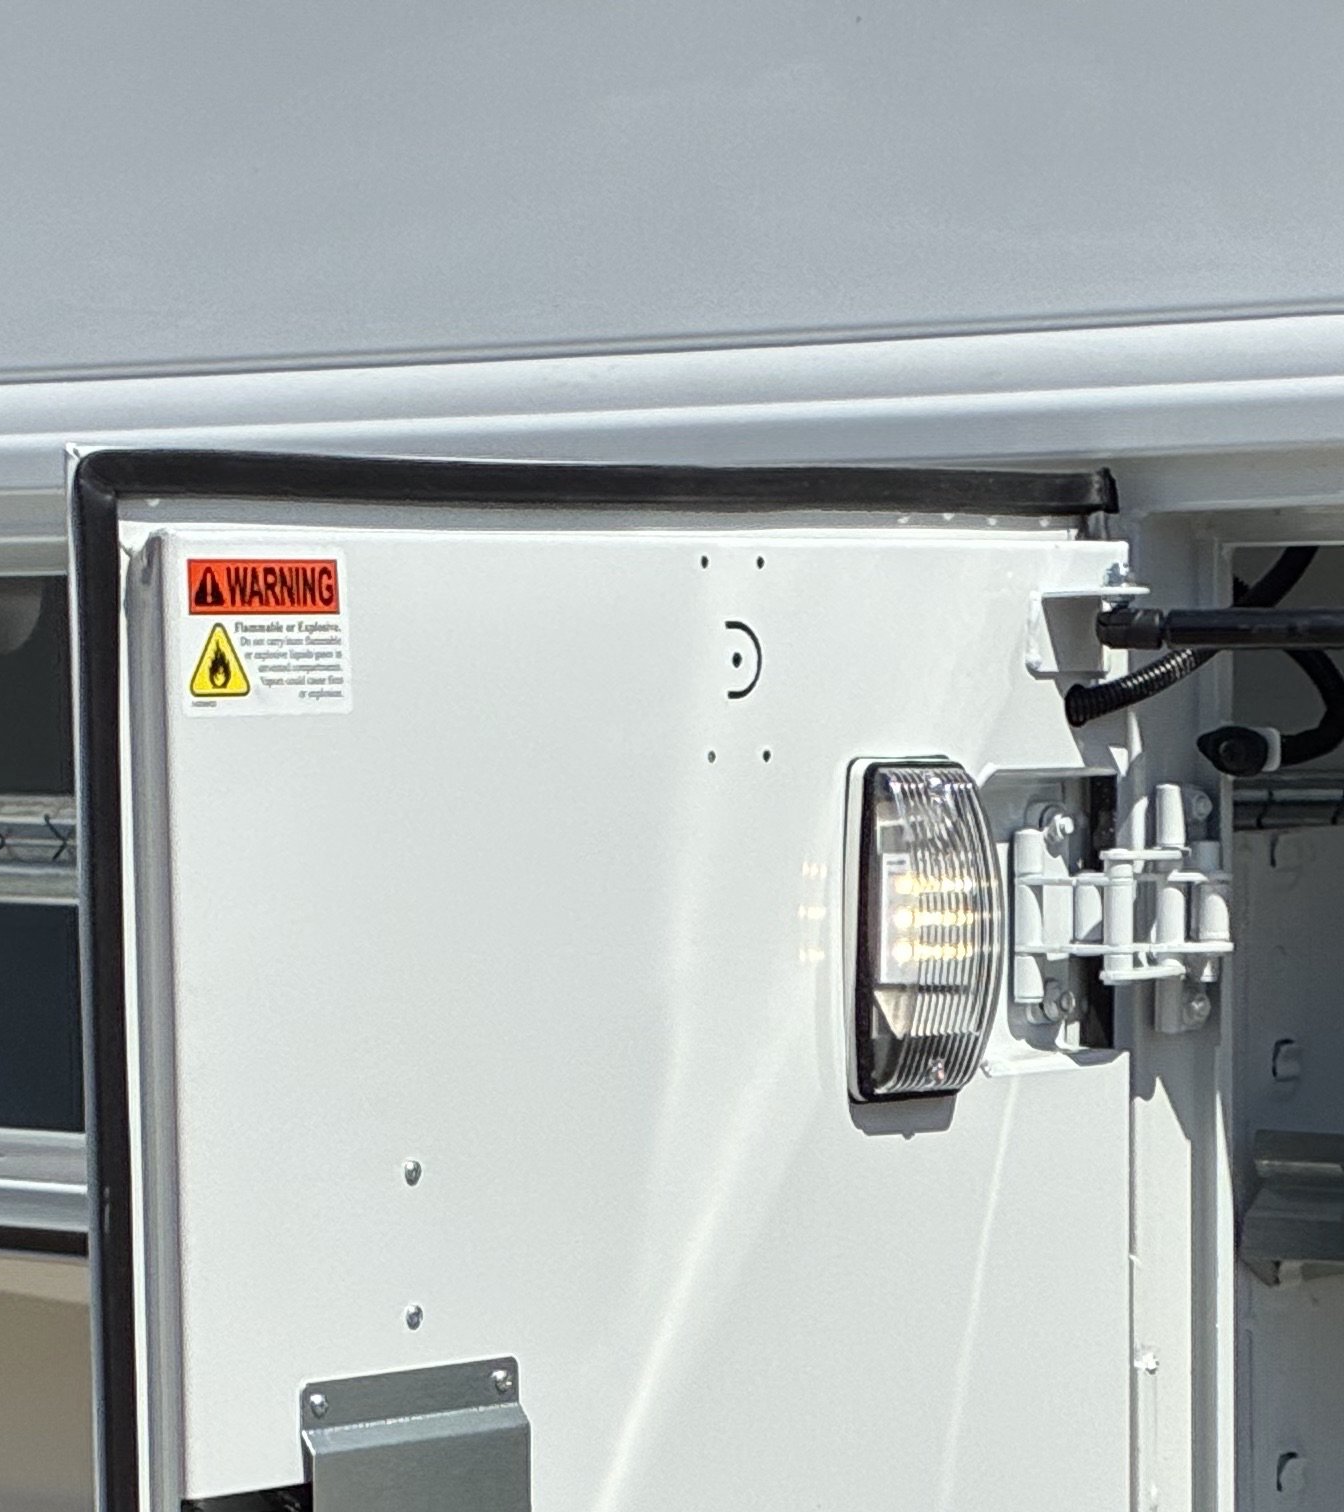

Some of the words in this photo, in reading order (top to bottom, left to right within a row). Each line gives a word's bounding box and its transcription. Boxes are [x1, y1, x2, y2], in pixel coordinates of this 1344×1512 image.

[226, 566, 333, 606] WARNING
[234, 621, 283, 633] Flammable
[298, 621, 341, 635] Explosive.
[240, 636, 251, 646] Do
